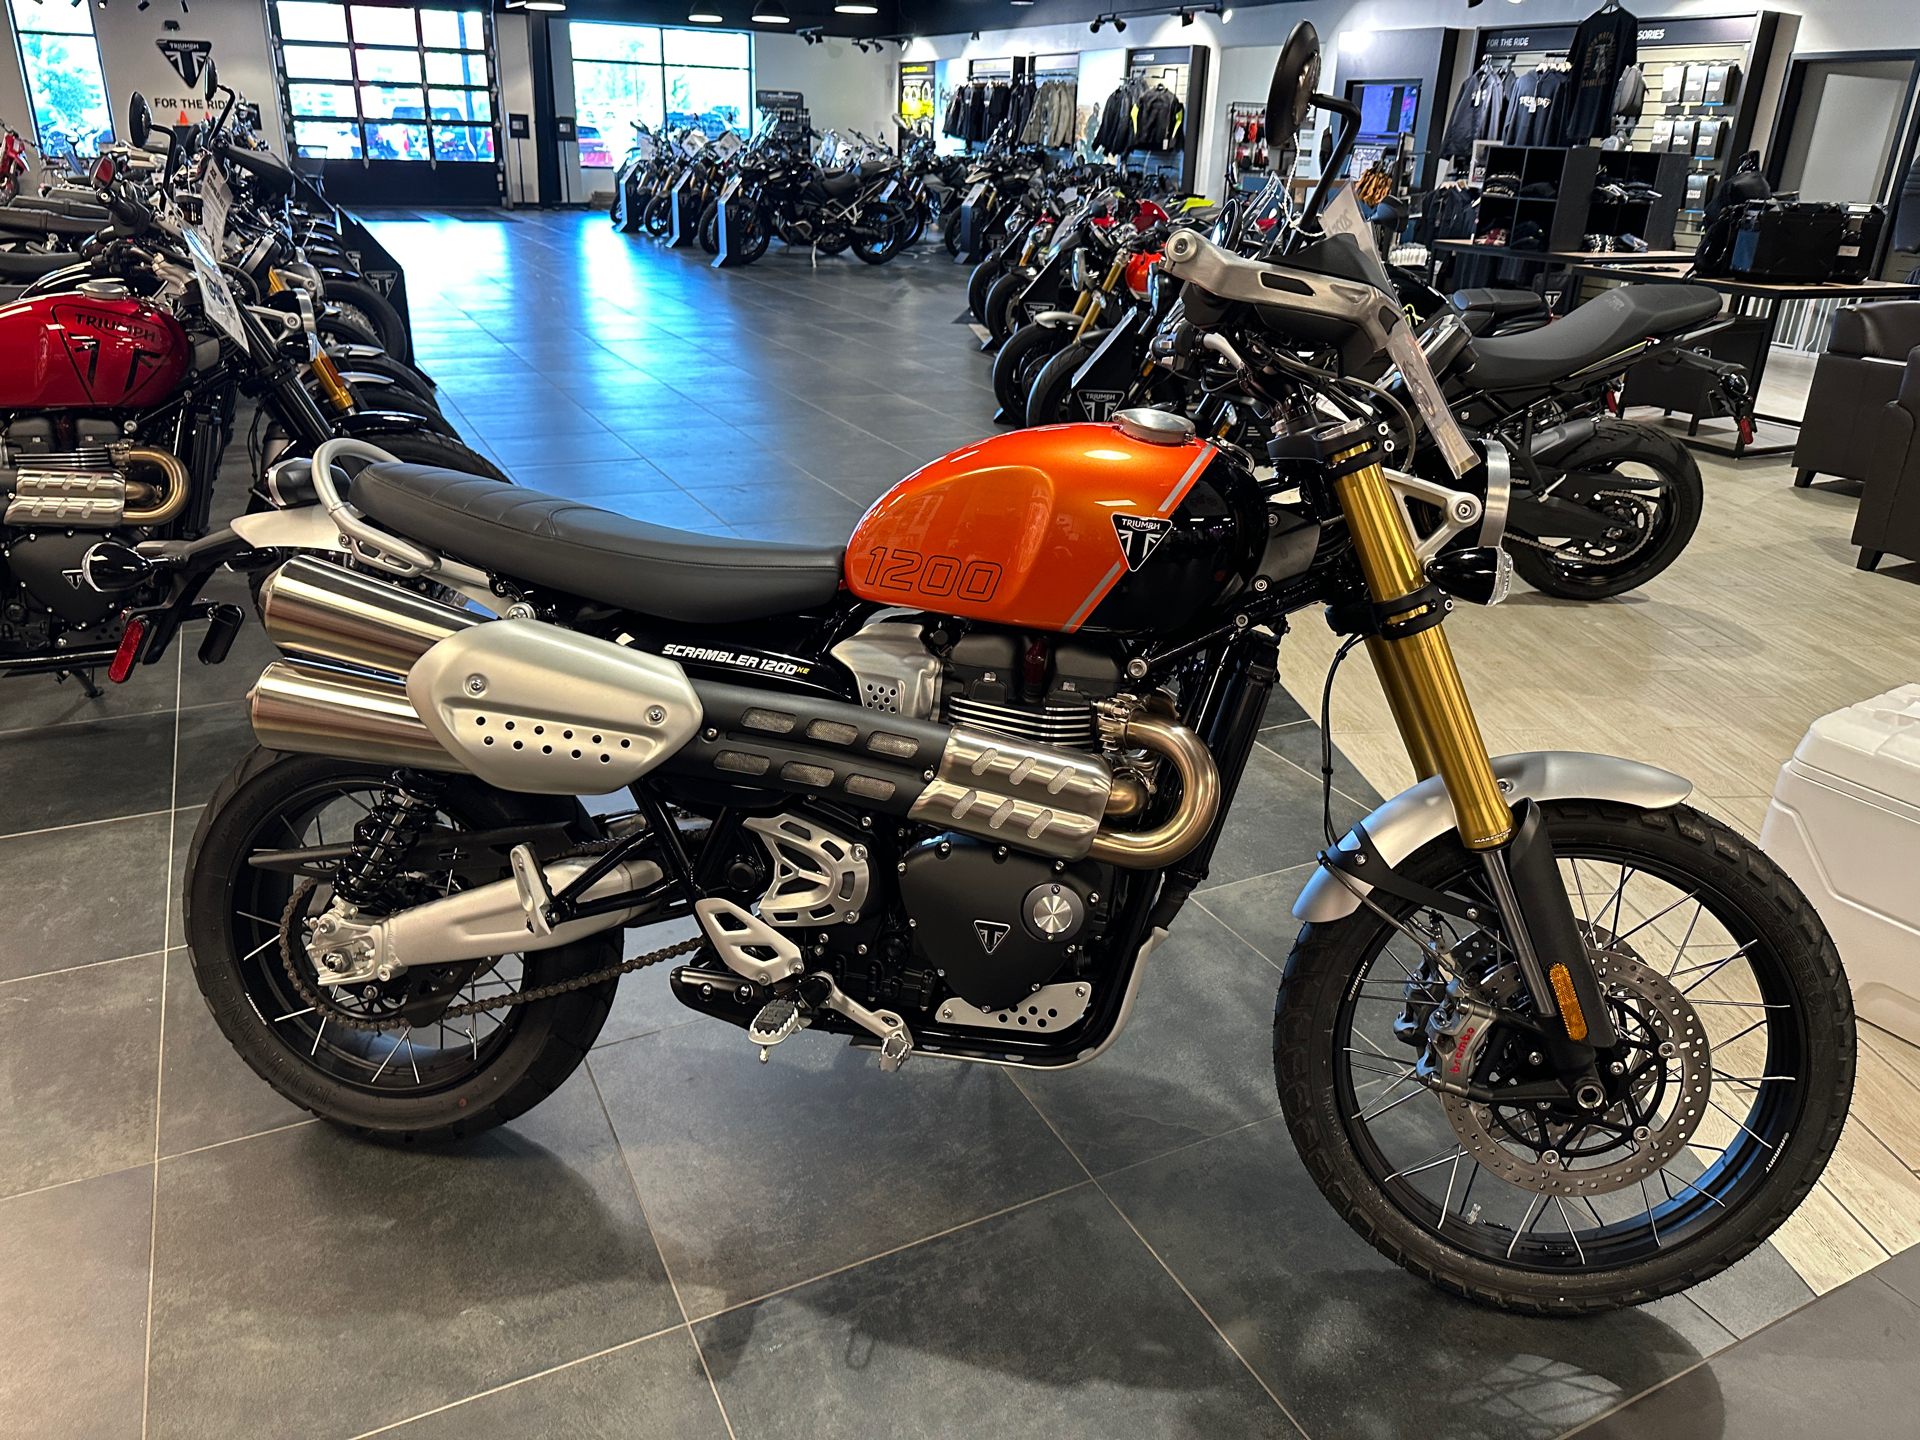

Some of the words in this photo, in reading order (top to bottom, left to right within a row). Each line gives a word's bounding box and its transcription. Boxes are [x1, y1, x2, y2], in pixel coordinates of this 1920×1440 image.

[1486, 38, 1499, 47] FOR
[1500, 38, 1513, 47] THE
[1514, 37, 1530, 47] RIDE
[154, 97, 178, 108] FOR
[180, 98, 203, 109] THE
[206, 100, 228, 110] RID
[75, 313, 156, 342] TRIUMPH
[1085, 392, 1116, 401] TRIUMPH
[1121, 518, 1161, 531] TRIUMPH
[865, 546, 1003, 602] 1200
[661, 643, 760, 668] SCRAMBLER
[758, 658, 798, 675] 1200
[1448, 1027, 1475, 1074] brembo
